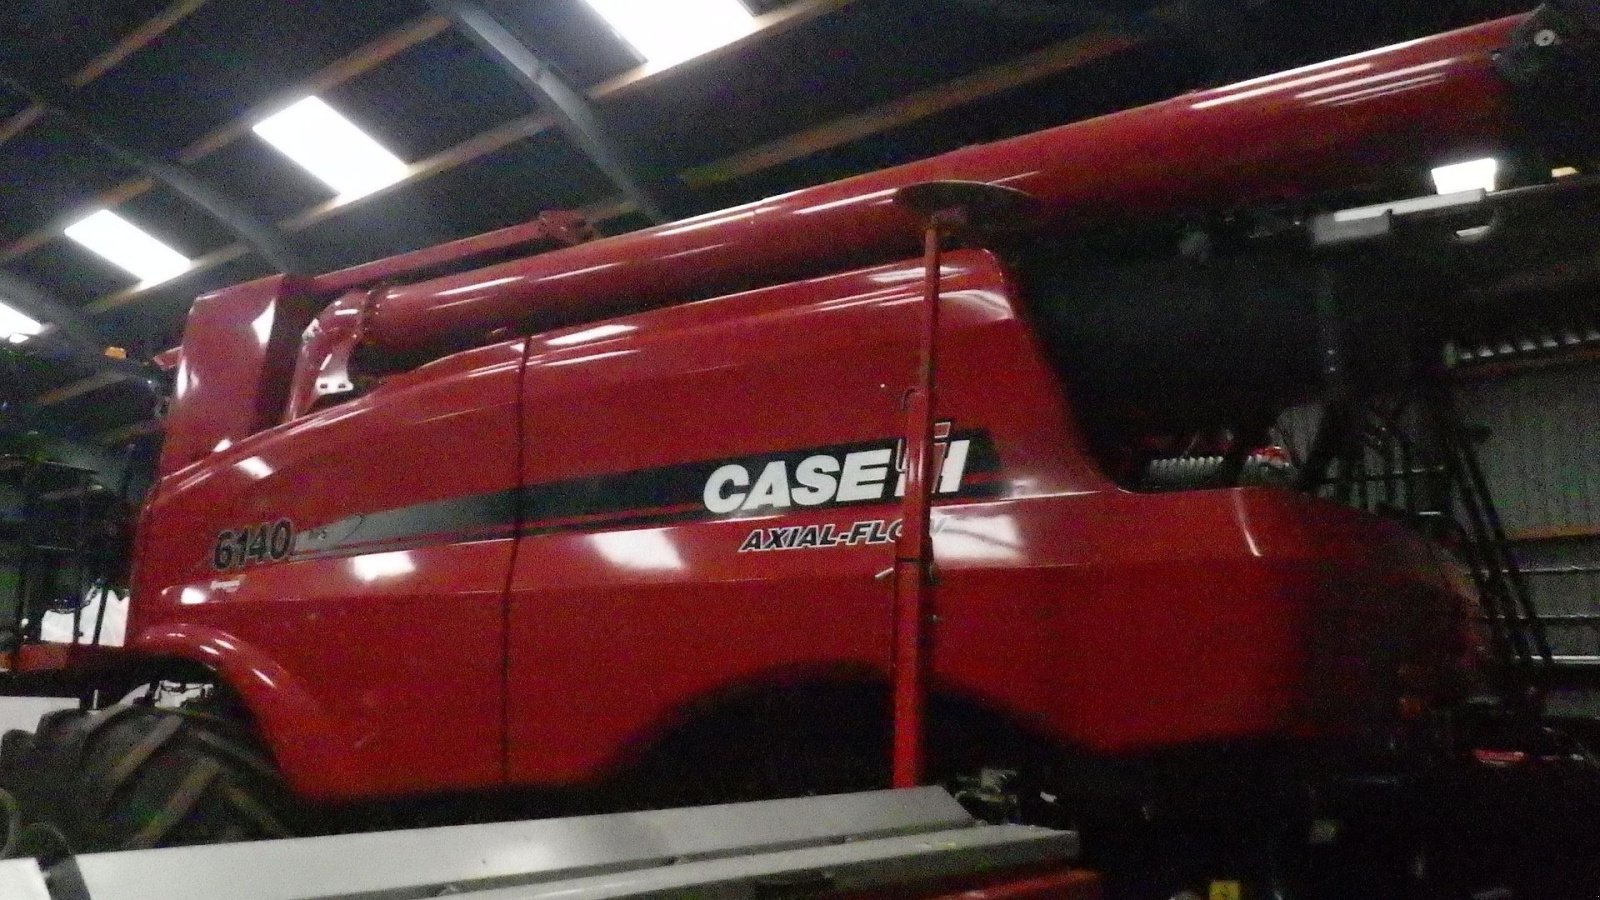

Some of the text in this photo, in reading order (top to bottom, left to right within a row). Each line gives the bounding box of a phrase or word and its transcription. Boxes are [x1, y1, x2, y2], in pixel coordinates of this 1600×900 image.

[703, 448, 891, 514] CASE
[213, 520, 290, 568] 6140
[738, 516, 946, 553] AXIAL-FLO
